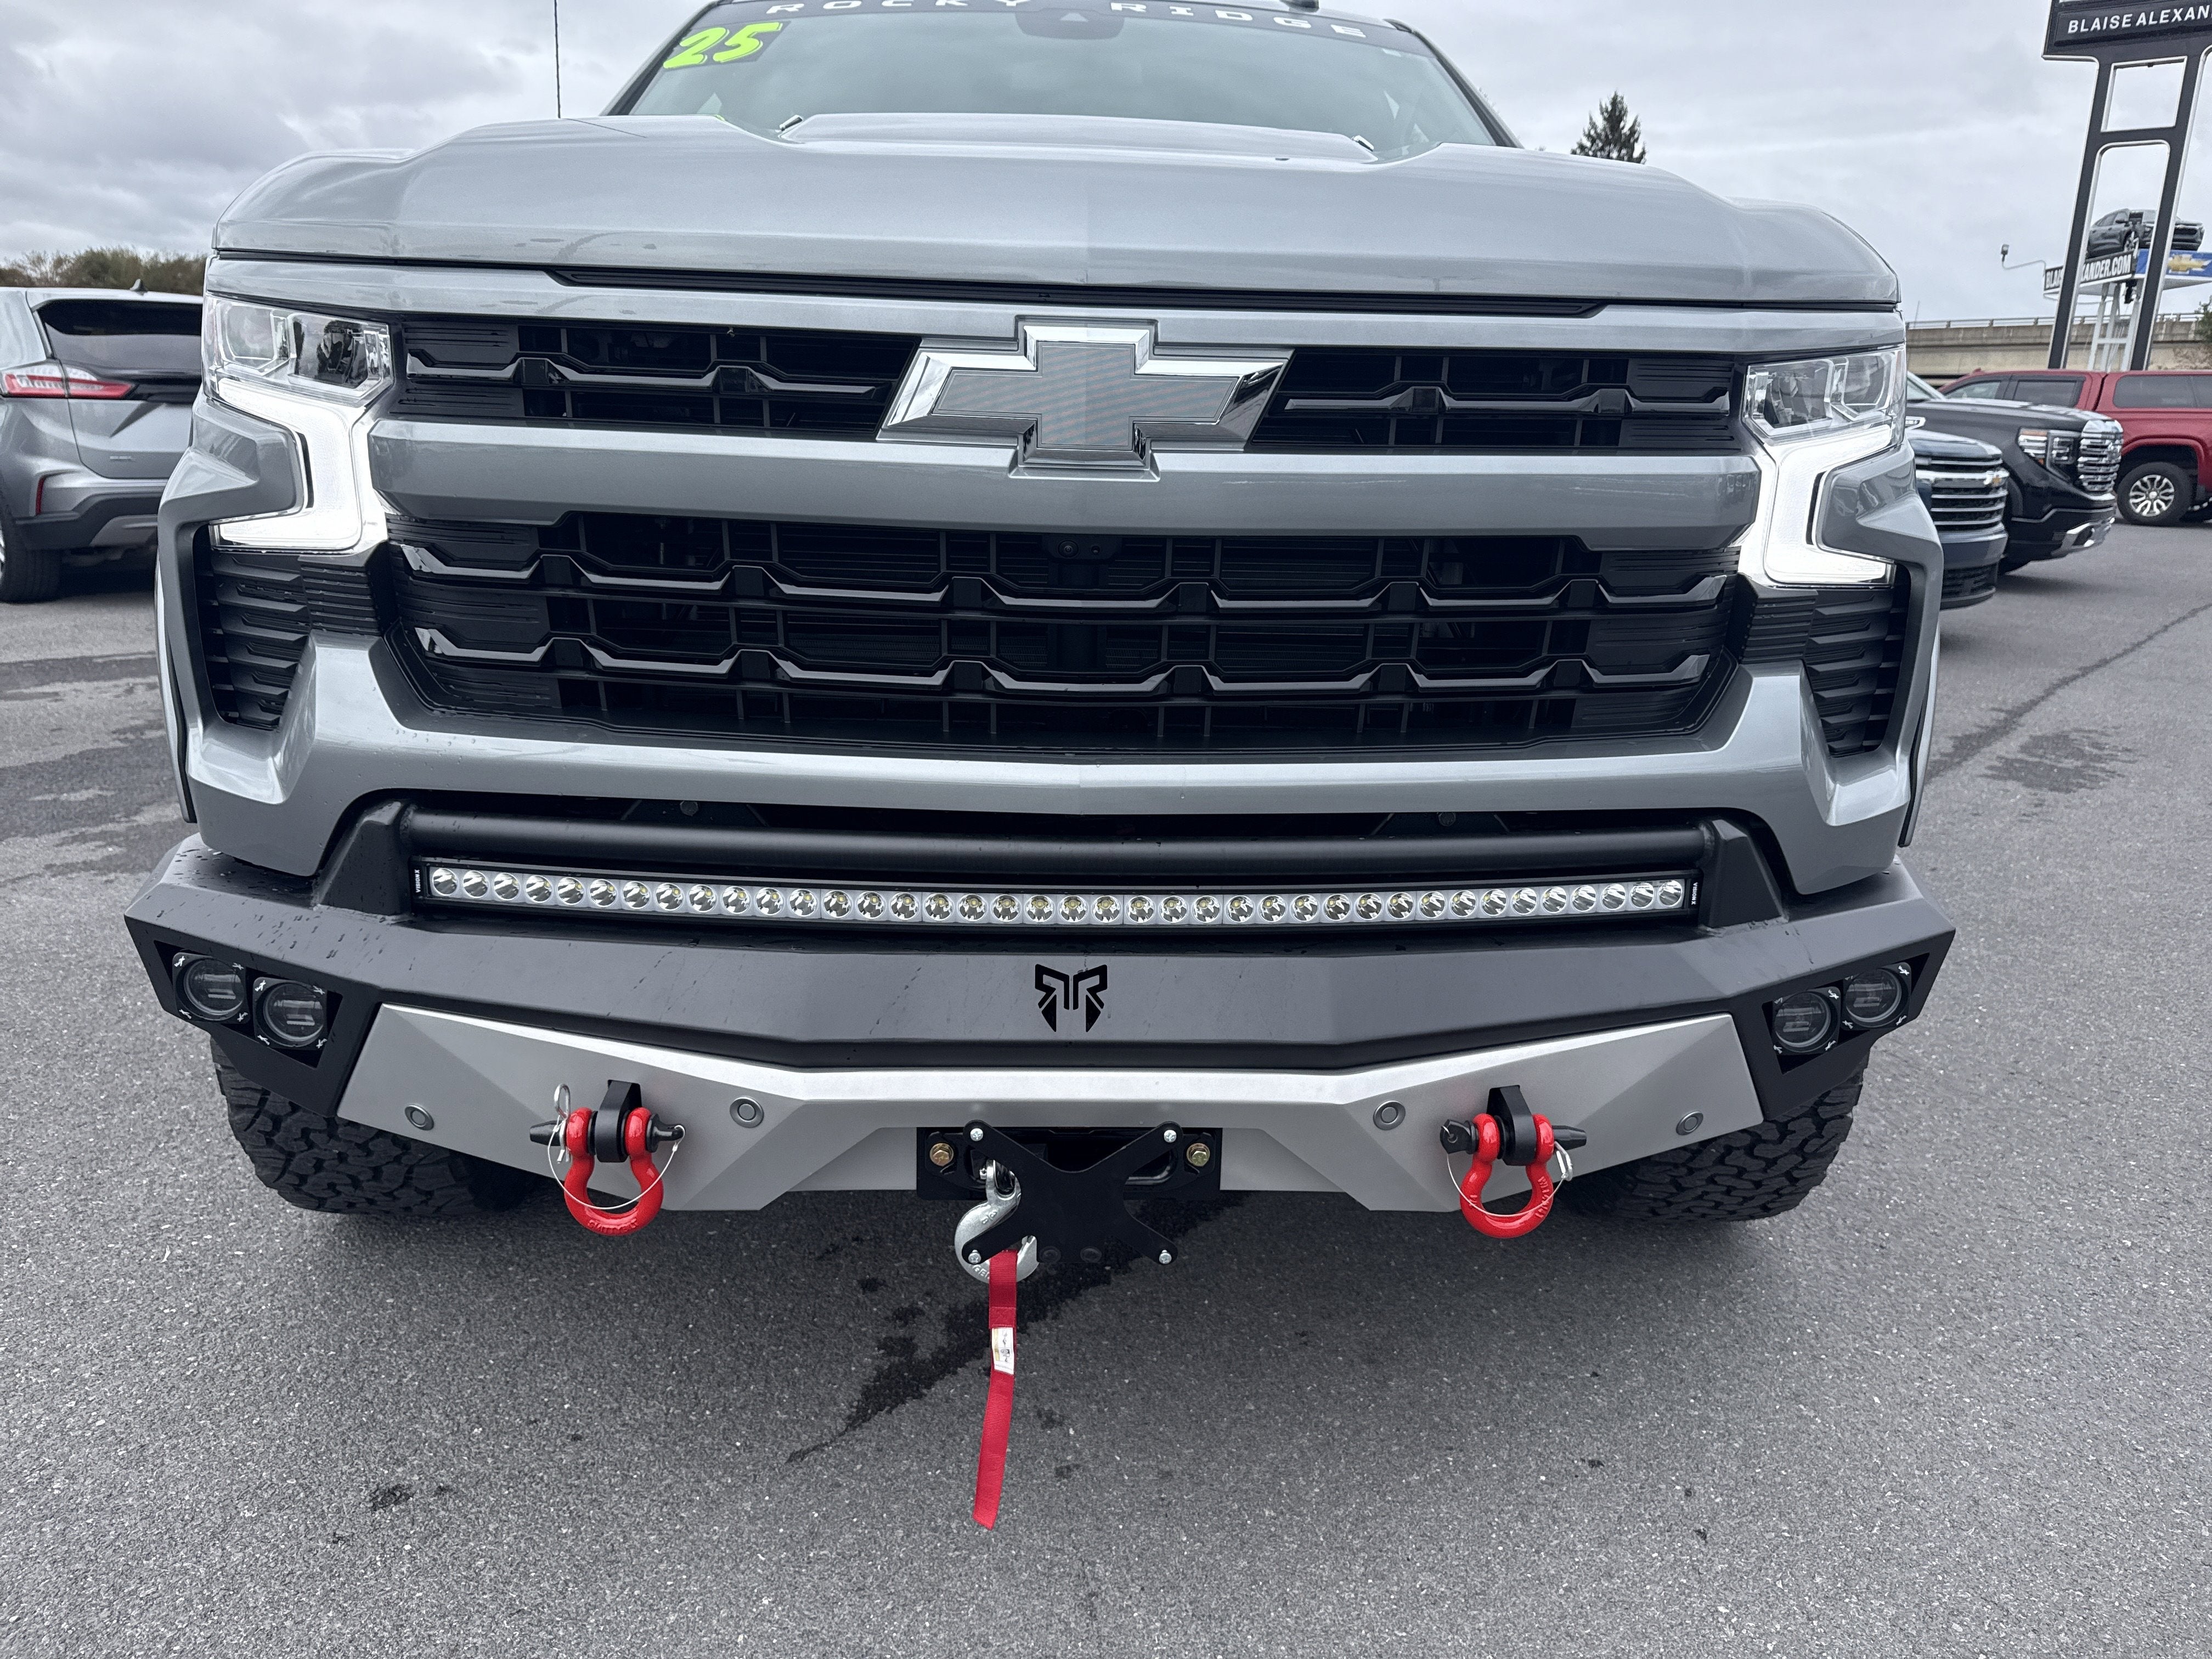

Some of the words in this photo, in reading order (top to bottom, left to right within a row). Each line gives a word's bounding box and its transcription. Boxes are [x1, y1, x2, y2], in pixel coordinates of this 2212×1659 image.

[766, 0, 1030, 14] ROCKY
[1111, 2, 1366, 37] RIDGE
[2067, 13, 2133, 34] BLAISE
[2135, 4, 2212, 26] ALEXAN
[663, 22, 782, 69] 25
